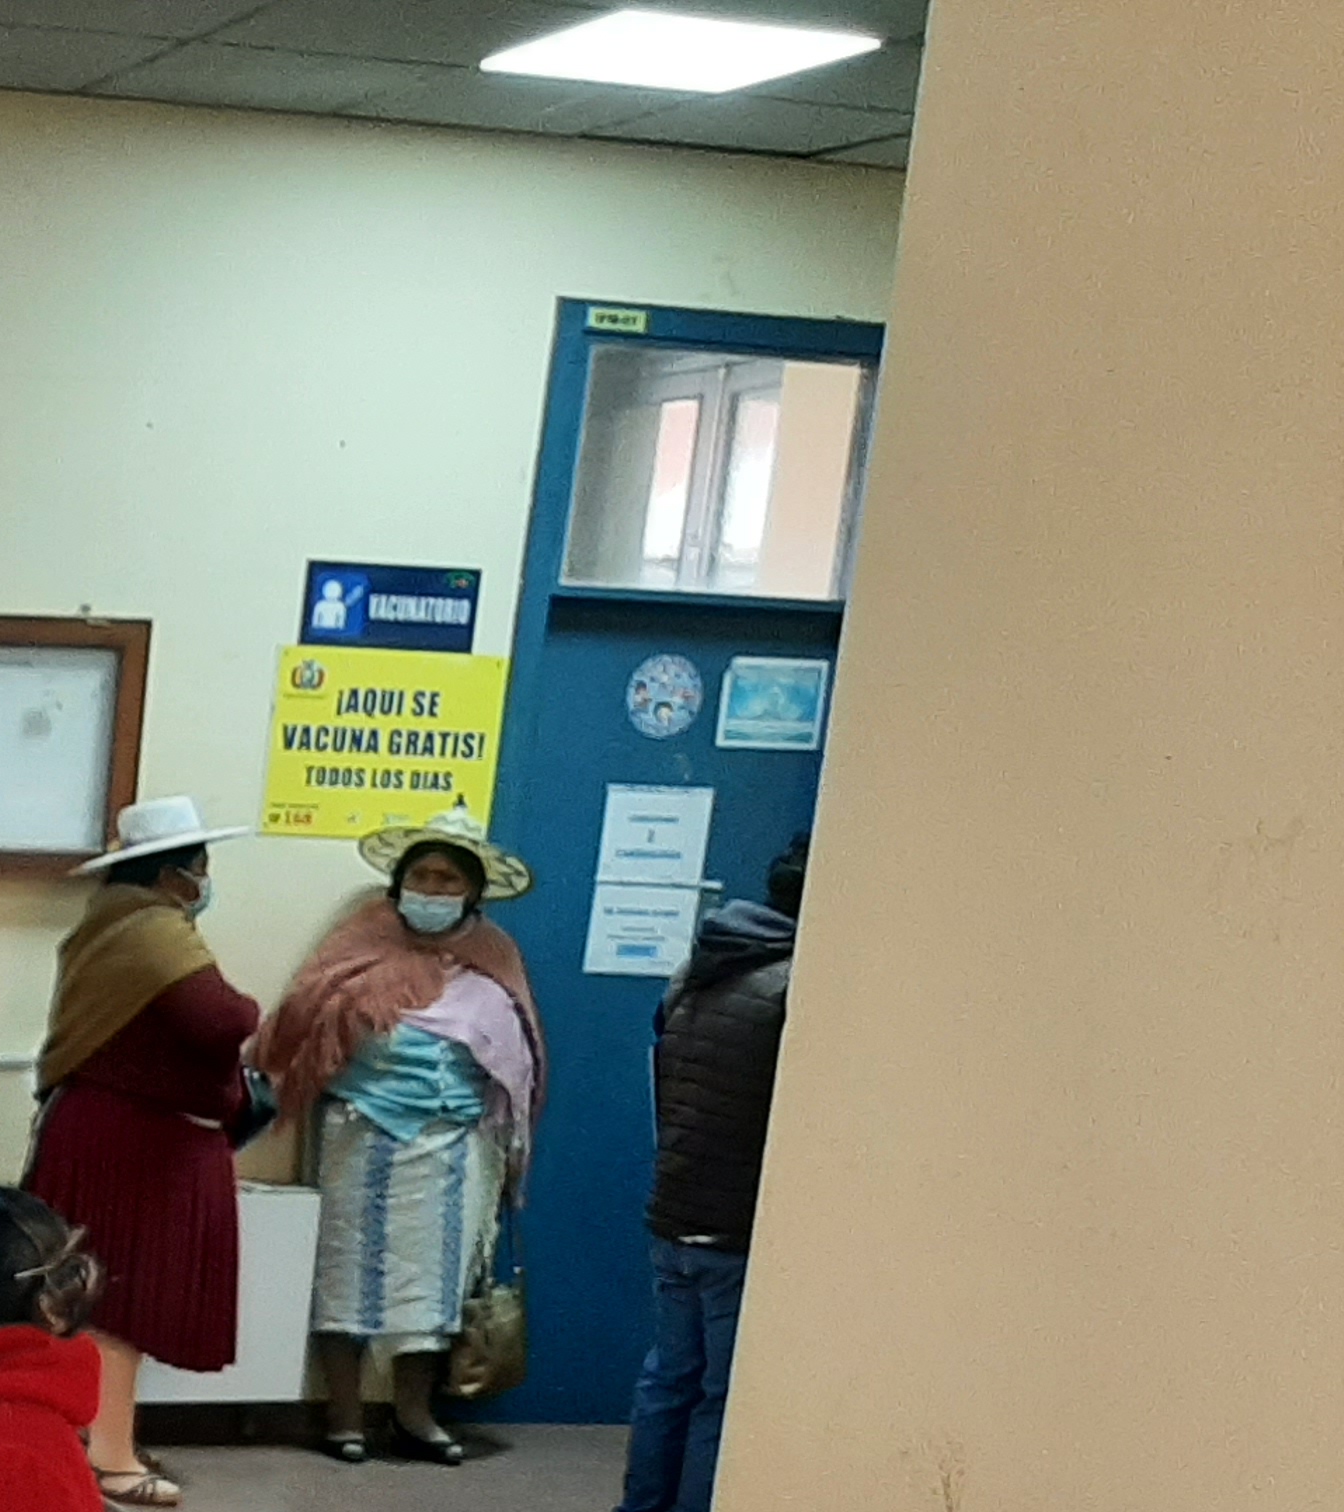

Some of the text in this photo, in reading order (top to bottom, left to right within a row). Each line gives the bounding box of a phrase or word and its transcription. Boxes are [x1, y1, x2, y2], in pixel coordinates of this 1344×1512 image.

[336, 688, 440, 718] ¡AQUI SE
[282, 724, 486, 760] VACUNA GRATIS!
[304, 765, 453, 791] TODOS LOS DIAS
